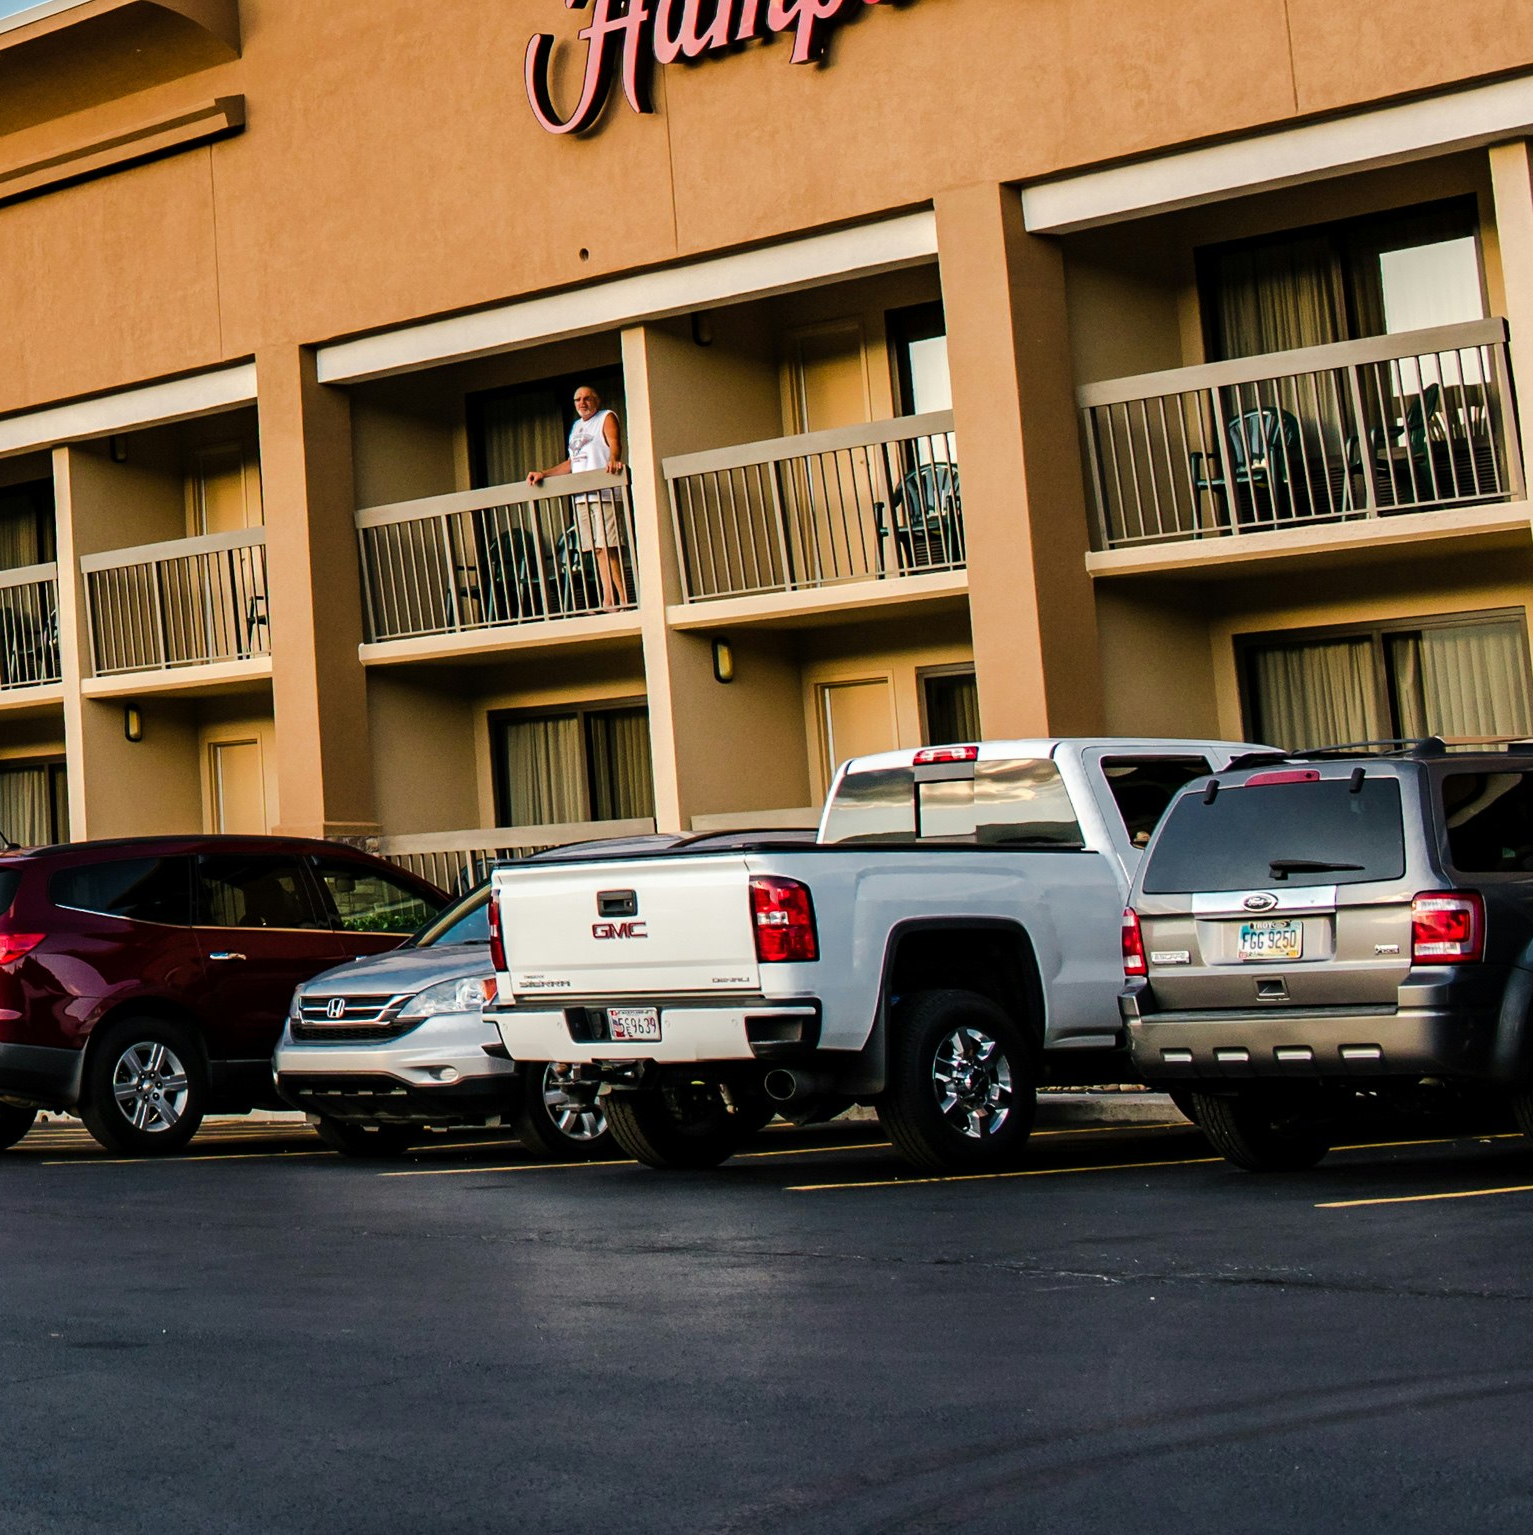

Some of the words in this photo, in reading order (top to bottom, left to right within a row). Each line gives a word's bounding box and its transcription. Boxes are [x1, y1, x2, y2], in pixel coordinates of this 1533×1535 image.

[591, 921, 647, 939] GMC
[1242, 931, 1264, 950] FGG
[1267, 929, 1296, 949] 9250
